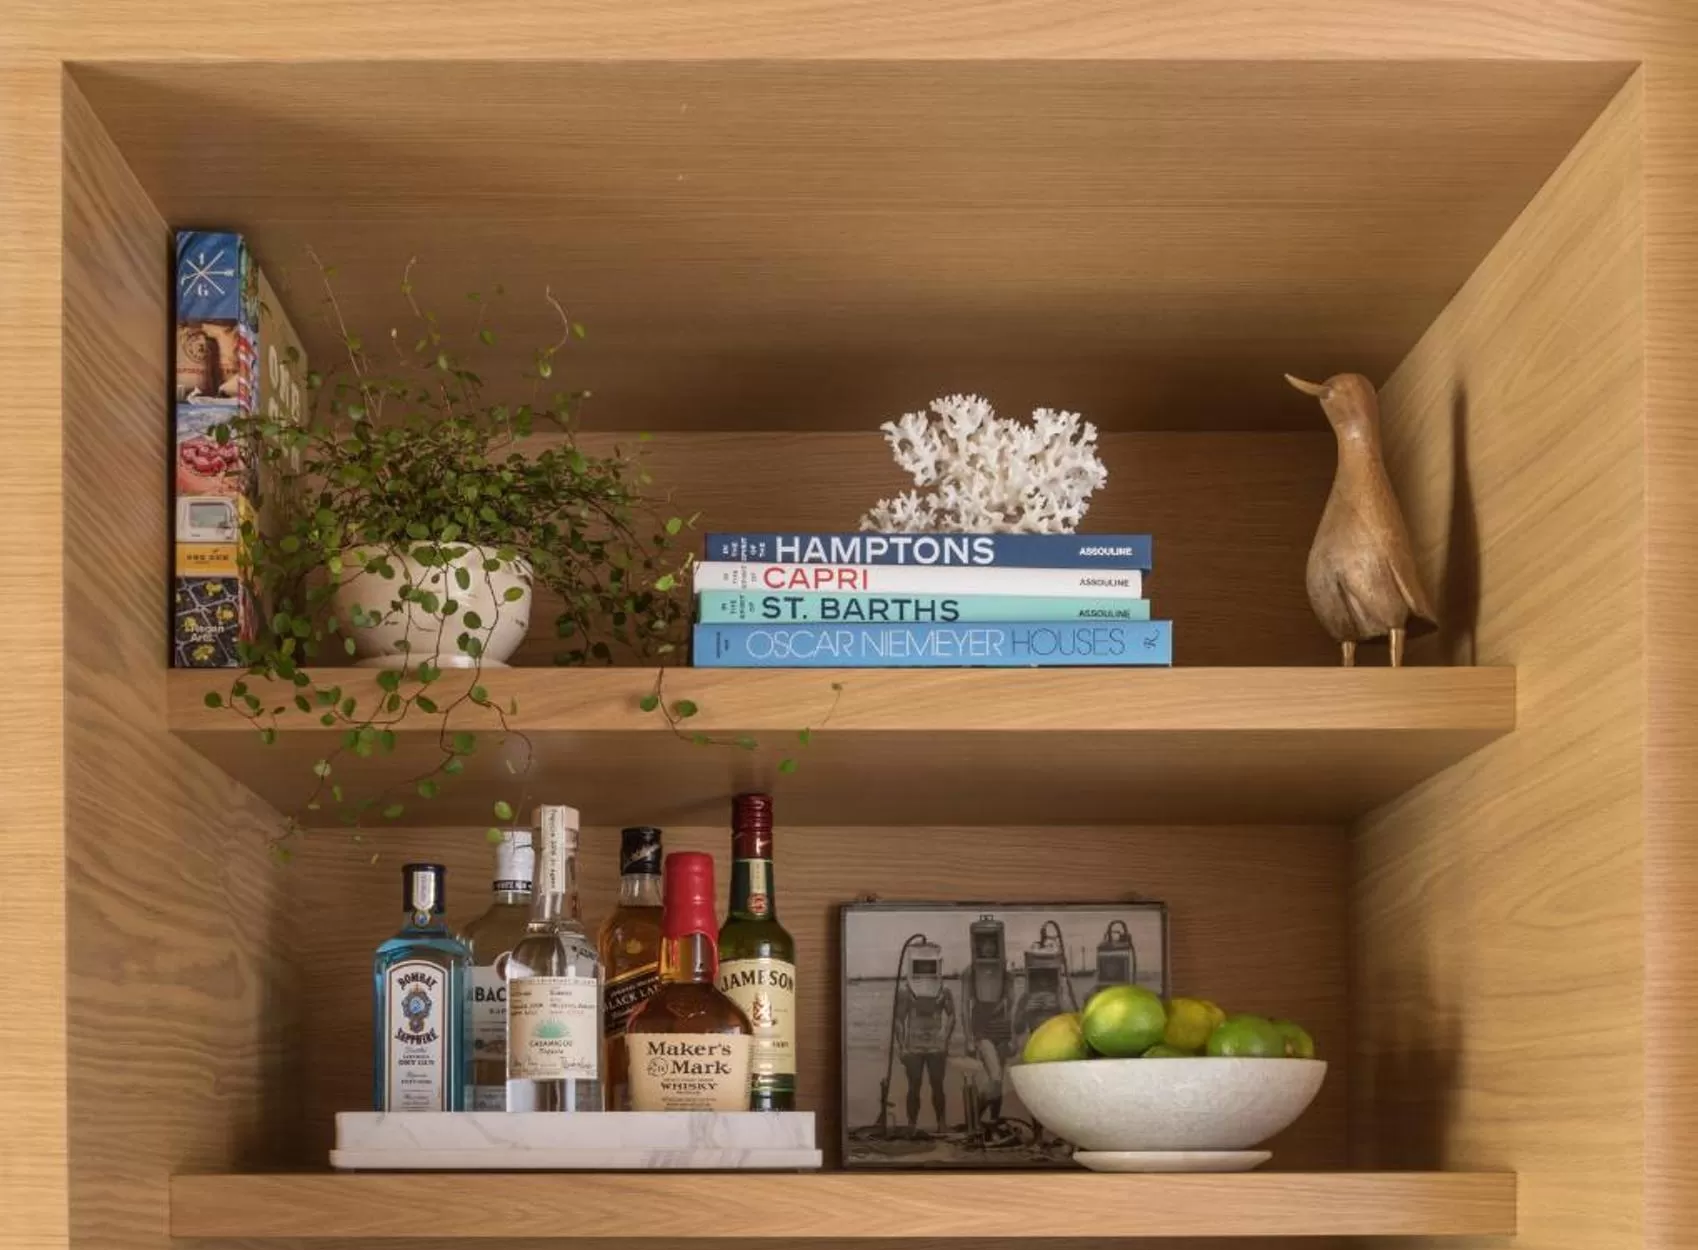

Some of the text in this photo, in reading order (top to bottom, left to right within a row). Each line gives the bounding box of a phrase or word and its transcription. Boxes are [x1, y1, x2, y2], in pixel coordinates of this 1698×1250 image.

[775, 536, 1133, 564] HAMPTONS ASSOULINE
[763, 566, 868, 590] CAPRI
[1079, 577, 1130, 588] ASSOULINE
[761, 596, 1131, 621] ST. BARTHS ASSOULINE
[746, 630, 854, 659] OSCAR
[861, 629, 1005, 657] NIEMEYER
[1011, 628, 1126, 656] HOUSES
[397, 972, 438, 991] BOMBAY
[720, 969, 794, 994] JAMESON
[395, 1027, 439, 1045] SAPPHIRE
[647, 1040, 732, 1056] Maker's
[671, 1059, 732, 1075] Mark
[660, 1081, 718, 1091] WHISKY
